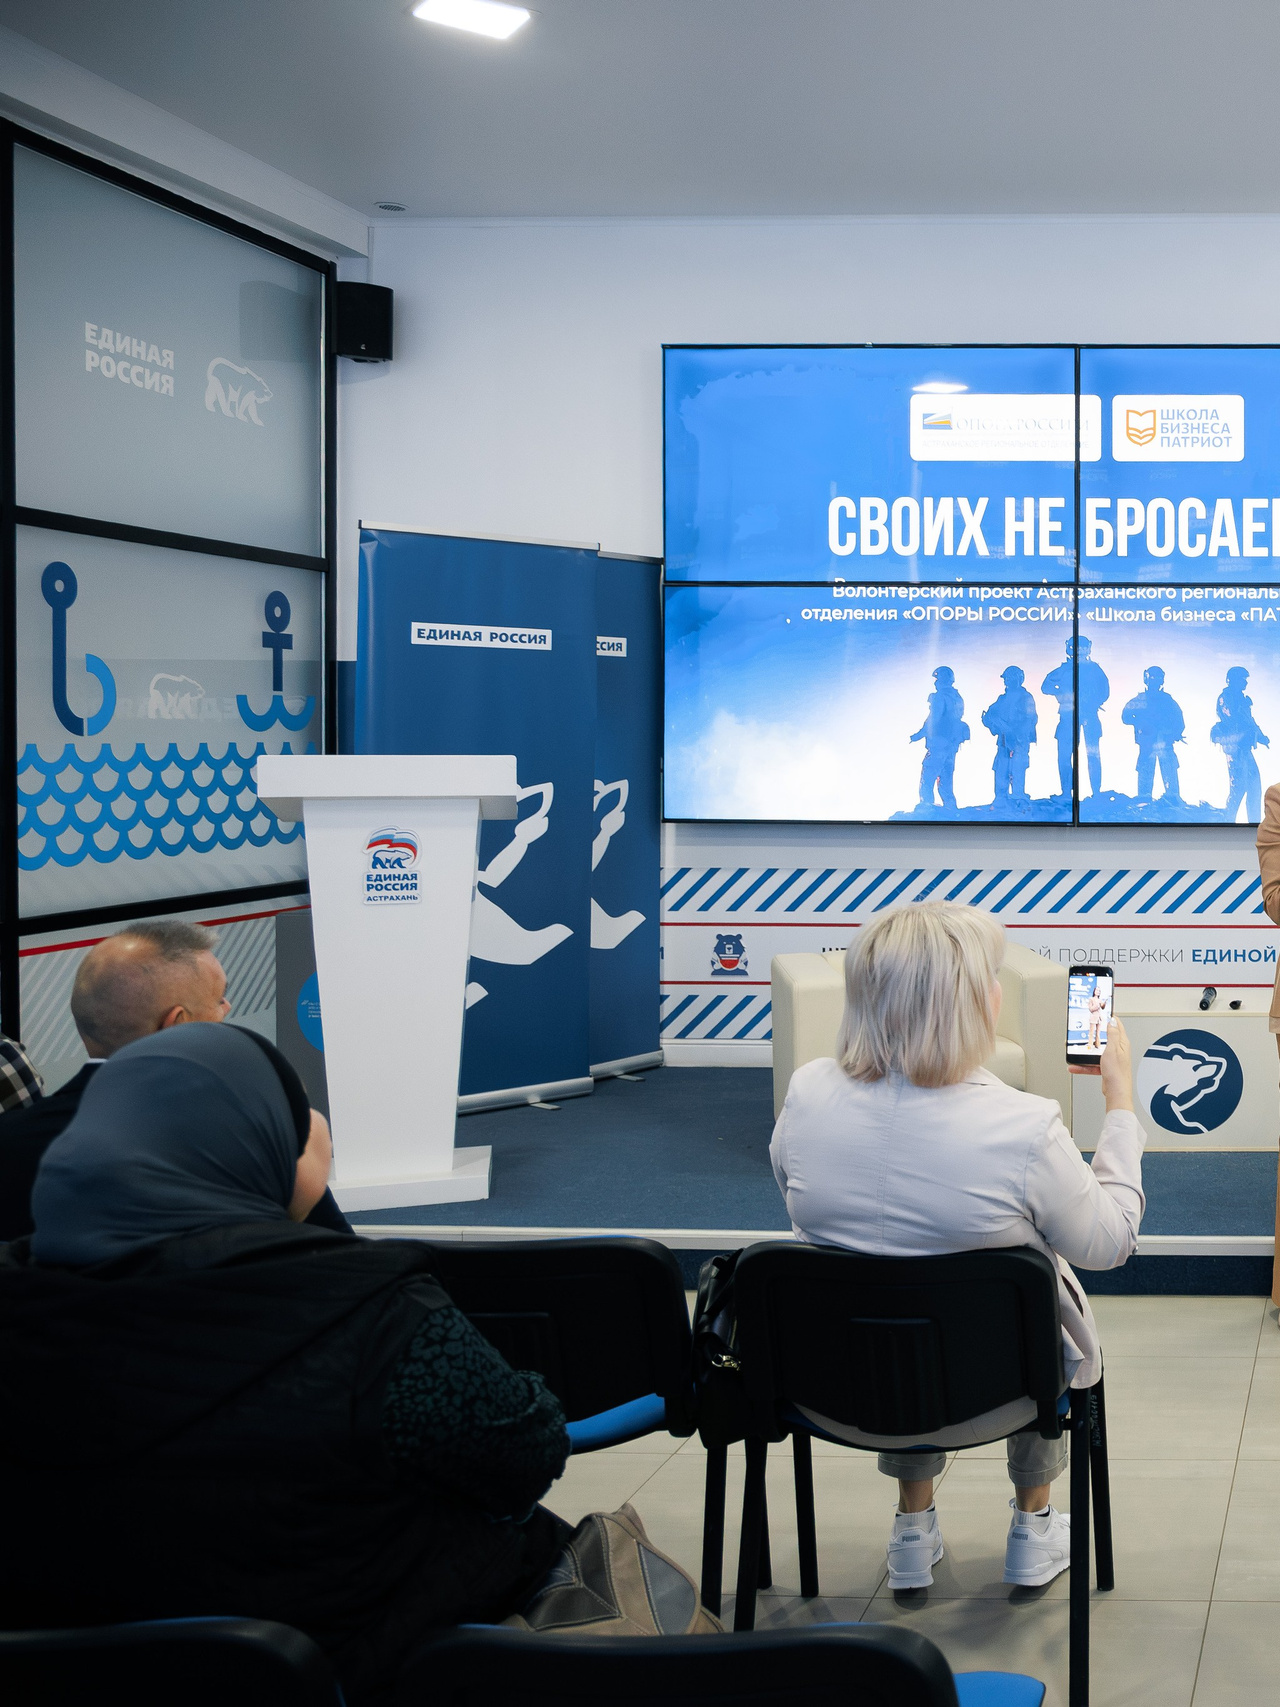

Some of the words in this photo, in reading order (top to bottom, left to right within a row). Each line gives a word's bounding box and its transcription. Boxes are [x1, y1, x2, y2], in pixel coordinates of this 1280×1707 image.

[85, 321, 174, 370] ЕДИНАЯ
[85, 349, 174, 397] РОССИЯ
[1160, 409, 1219, 420] ШКОЛА
[1160, 423, 1230, 434] БИЗНЕСА
[1160, 436, 1232, 447] ПАТРИОТ
[828, 496, 990, 556] СВОИХ
[1004, 497, 1066, 556] НЕ
[833, 578, 963, 601] Волонтерский
[969, 587, 1033, 601] проект
[1036, 578, 1177, 602] Астраханского
[801, 607, 898, 622] отделения
[902, 606, 983, 621] «ОПОРЫ
[1086, 606, 1156, 622] «Школа
[1164, 606, 1236, 622] бизнеса
[417, 628, 482, 642] ЕДИНАЯ
[489, 632, 547, 645] РОССИЯ
[366, 873, 418, 882] ЕДИНАЯ
[366, 883, 418, 891] РОССИЯ
[1059, 949, 1184, 965] ПОДДЕРЖКИ
[1192, 946, 1276, 964] ЕДИНОЙ
